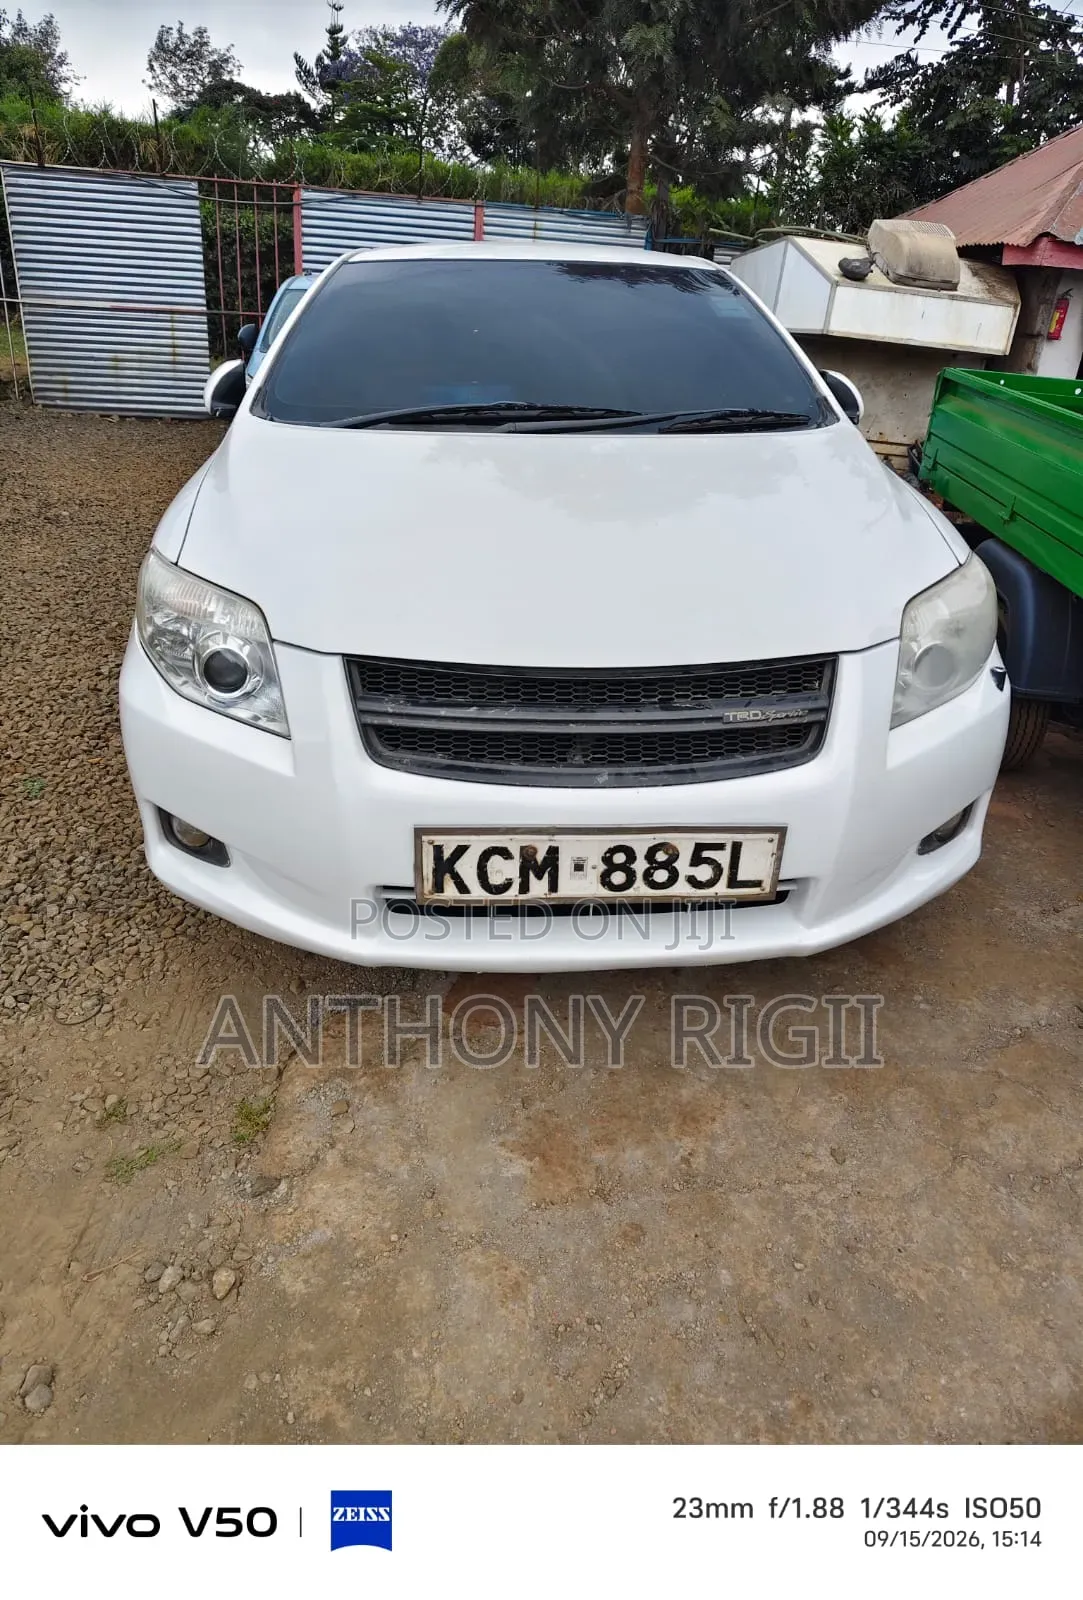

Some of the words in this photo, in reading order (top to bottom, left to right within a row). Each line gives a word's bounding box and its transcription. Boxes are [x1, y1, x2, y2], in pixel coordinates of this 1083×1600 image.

[724, 710, 761, 722] TRD
[431, 843, 560, 896] KCM
[599, 840, 764, 893] 885L
